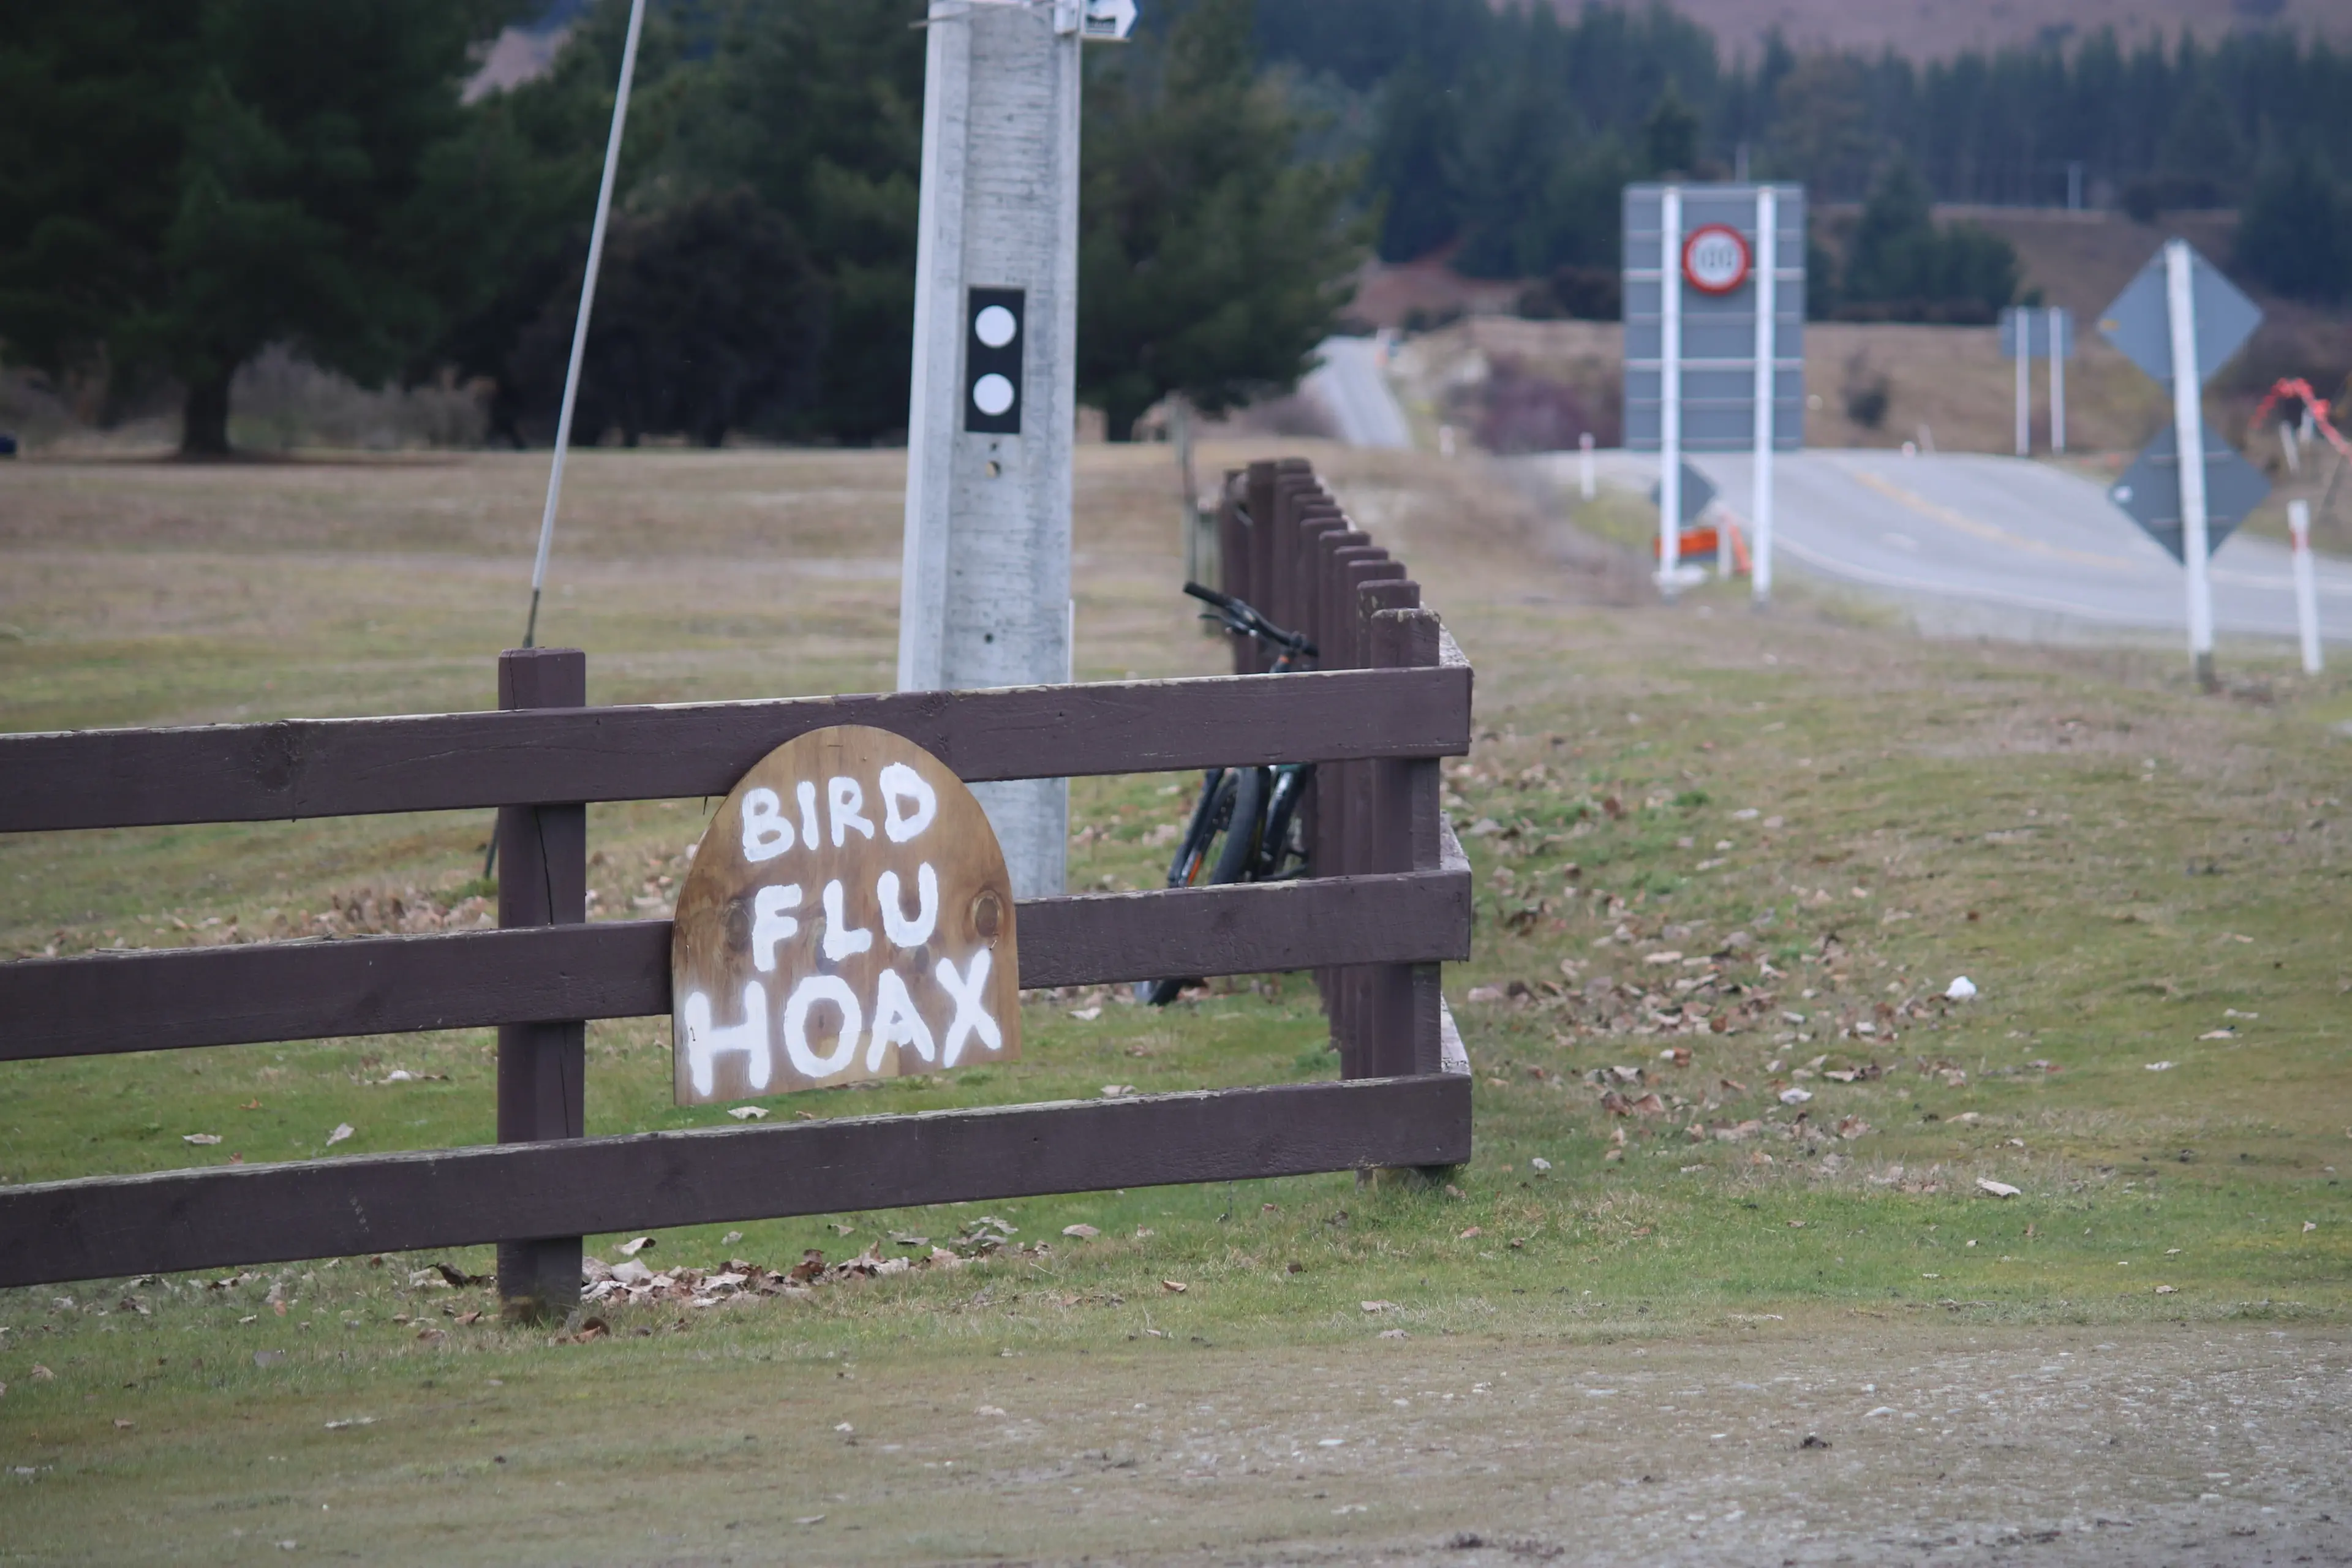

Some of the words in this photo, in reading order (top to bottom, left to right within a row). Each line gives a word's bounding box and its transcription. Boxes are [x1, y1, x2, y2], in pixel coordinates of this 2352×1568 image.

[741, 762, 936, 862] BIRD
[753, 862, 938, 971] FLU
[685, 948, 1001, 1096] HOAX
